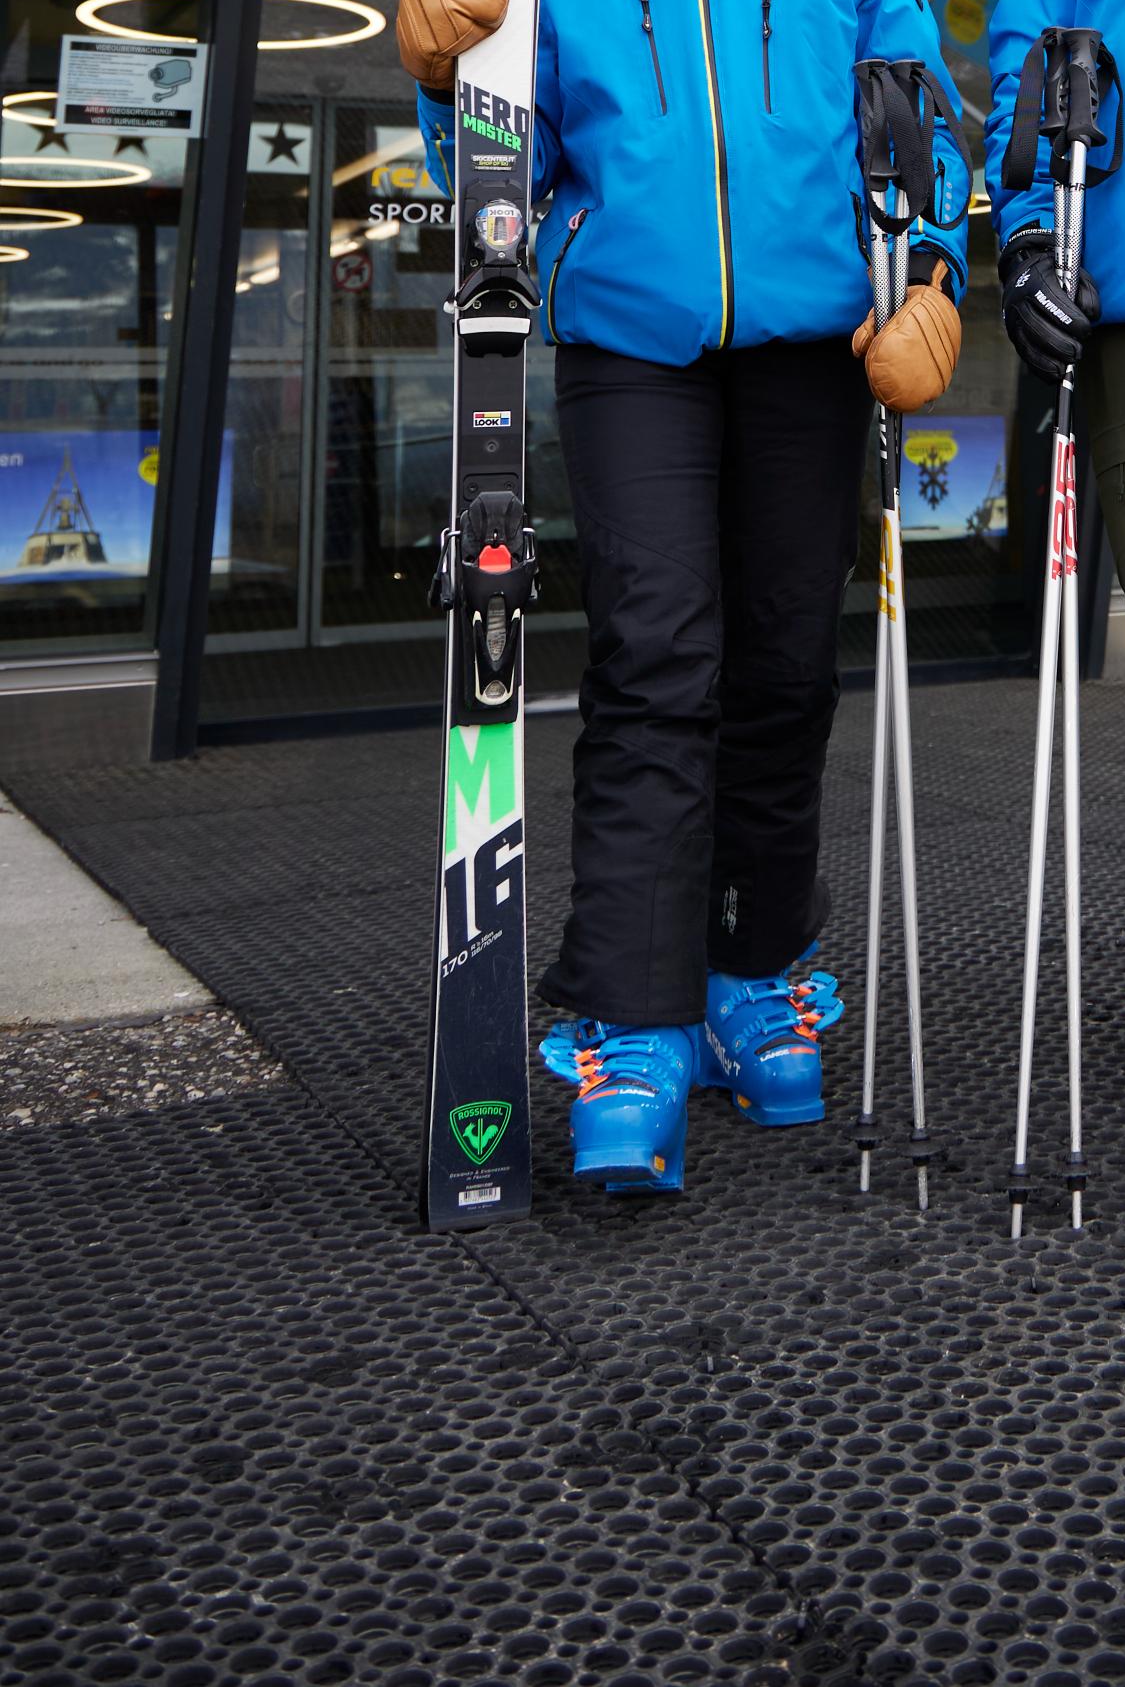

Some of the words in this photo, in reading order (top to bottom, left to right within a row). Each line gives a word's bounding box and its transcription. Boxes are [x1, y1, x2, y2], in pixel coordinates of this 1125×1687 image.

[84, 106, 105, 114] AREA
[458, 79, 530, 135] HERO
[91, 117, 112, 125] VIDEO
[463, 113, 522, 152] MASTER
[445, 724, 515, 855] M
[444, 818, 523, 957] 16
[443, 950, 468, 978] 170
[760, 1050, 791, 1062] LANGE
[619, 1088, 656, 1097] LANGE
[458, 1106, 503, 1120] ROSSIGNOL
